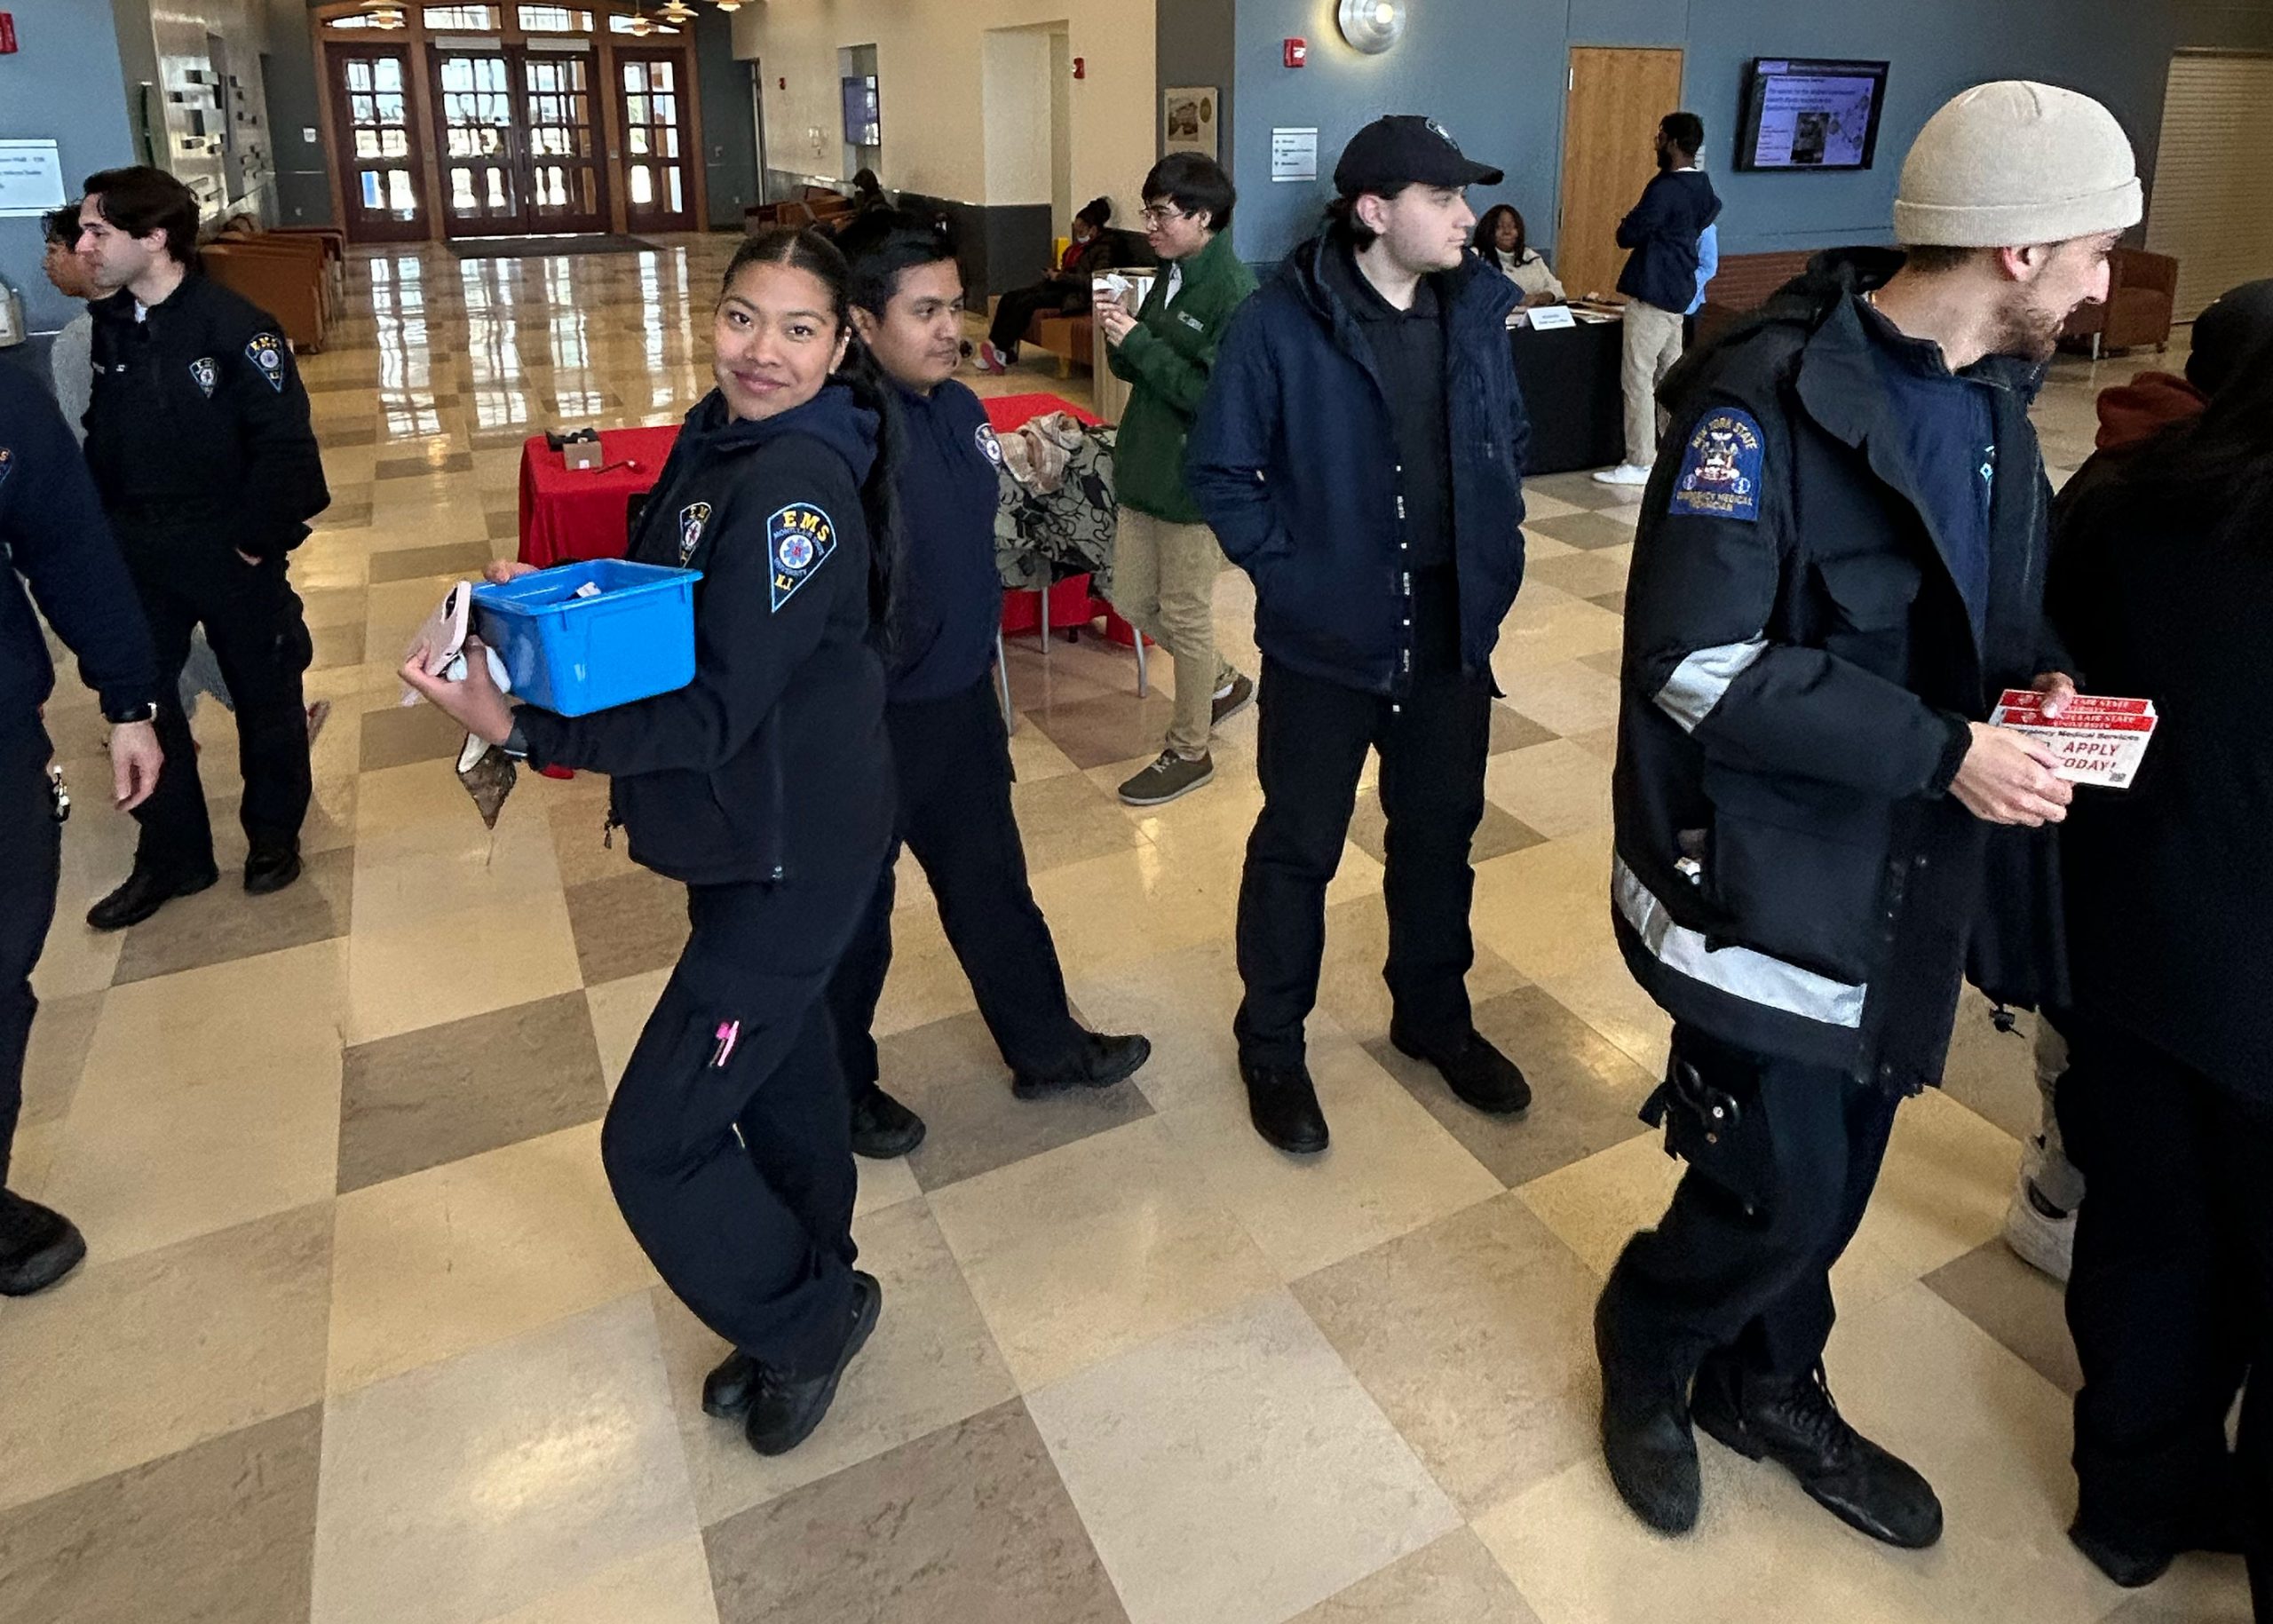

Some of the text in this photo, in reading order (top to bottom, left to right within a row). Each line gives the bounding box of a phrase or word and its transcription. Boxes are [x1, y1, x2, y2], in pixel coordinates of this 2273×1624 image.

[1732, 422, 1758, 449] STATE
[782, 511, 830, 542] EMS
[2104, 715, 2136, 724] STATE
[2058, 730, 2095, 739] Medical
[2097, 733, 2140, 741] Services
[2063, 741, 2121, 757] APPLY
[2061, 757, 2117, 772] ODAY!
